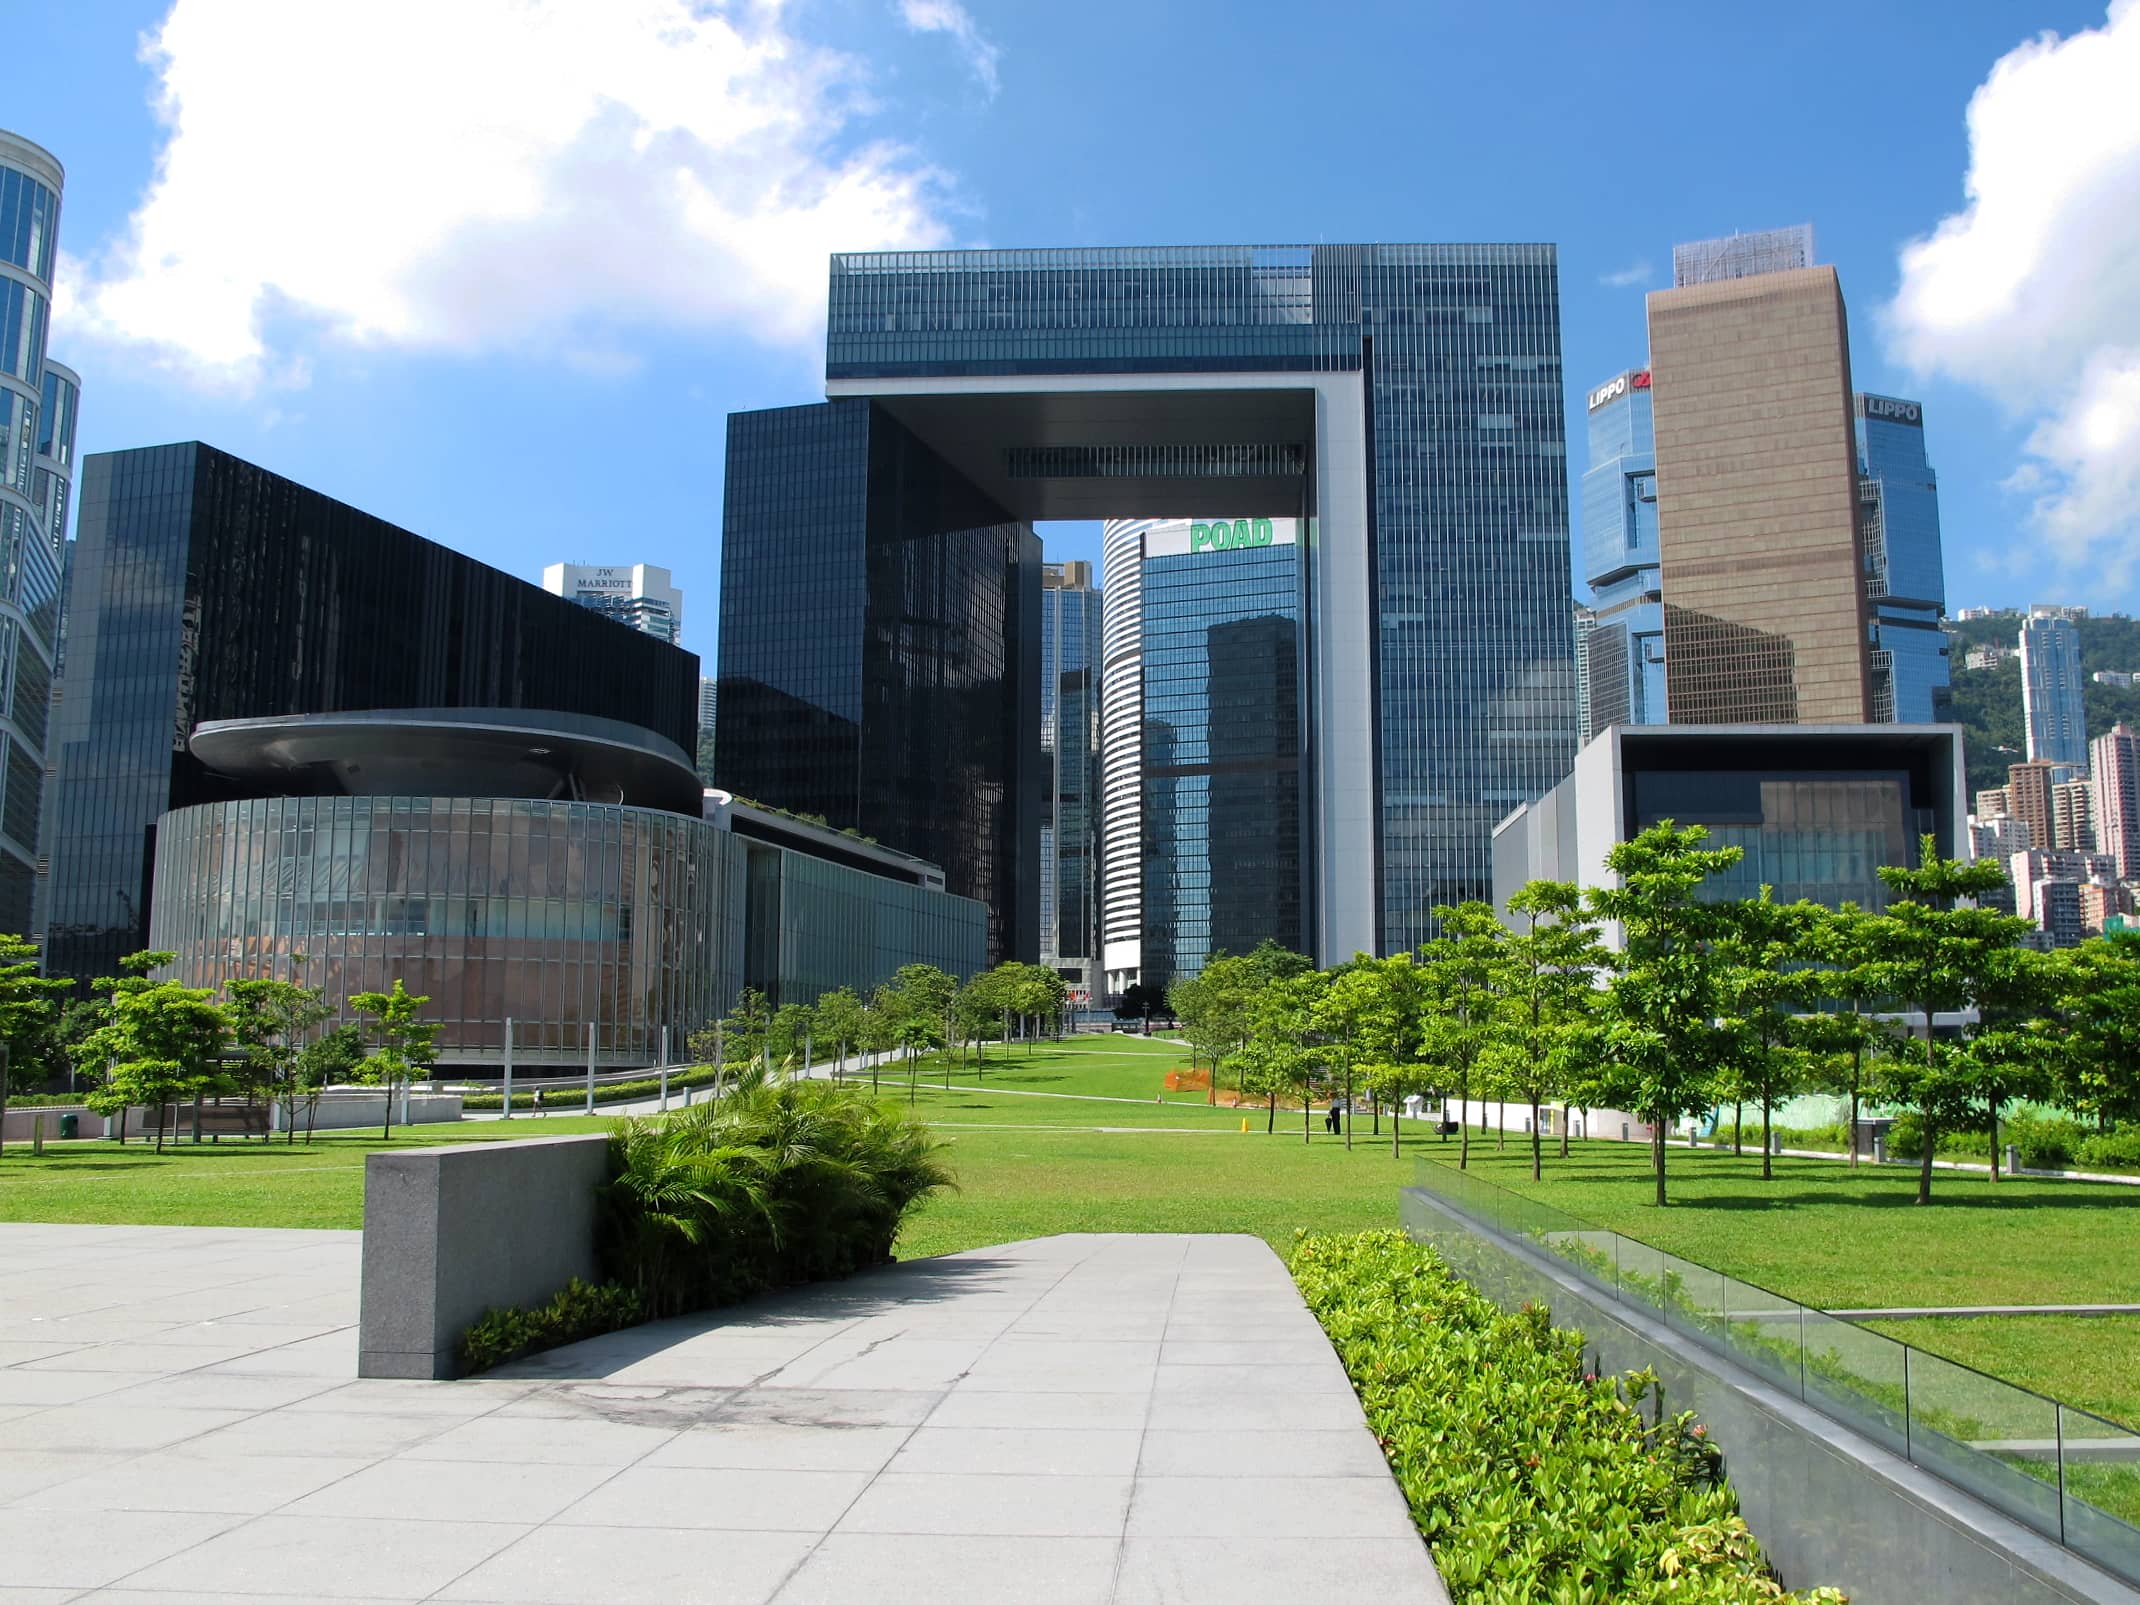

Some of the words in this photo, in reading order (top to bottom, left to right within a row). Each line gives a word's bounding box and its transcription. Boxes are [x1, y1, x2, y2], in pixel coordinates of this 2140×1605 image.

[1589, 377, 1625, 410] LIPPO
[1868, 398, 1918, 421] LIPPO
[1191, 518, 1273, 554] POAD
[577, 579, 632, 589] MARRIOTT
[597, 568, 614, 577] JW
